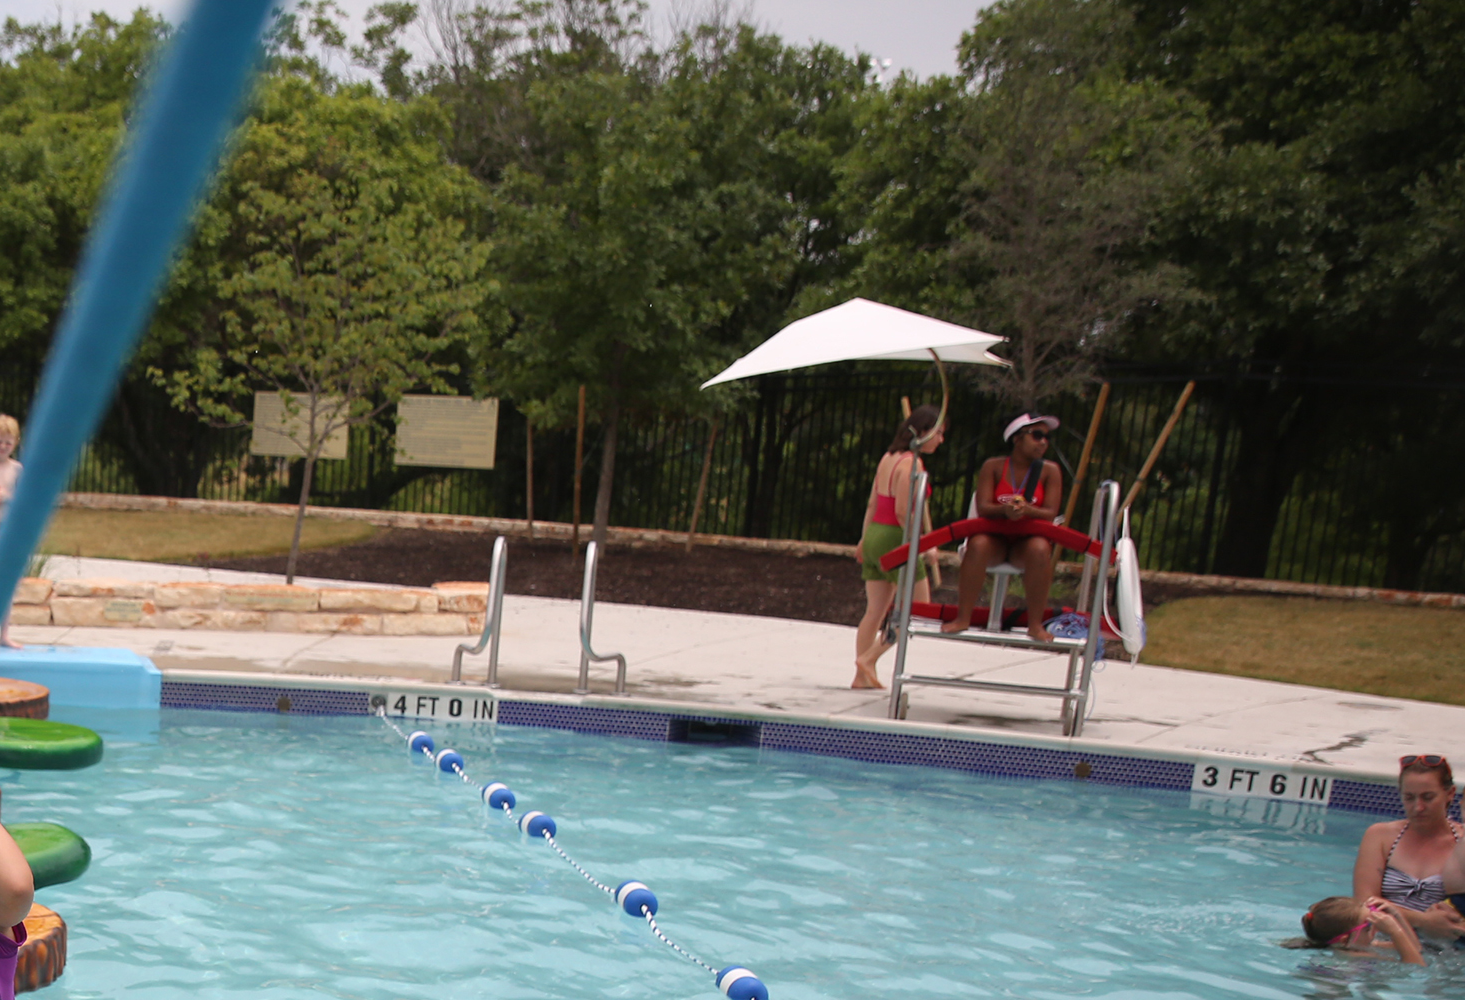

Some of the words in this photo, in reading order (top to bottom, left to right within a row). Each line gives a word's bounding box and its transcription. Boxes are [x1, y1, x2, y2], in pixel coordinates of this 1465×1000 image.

[394, 695, 407, 714] 4
[416, 696, 439, 715] FT
[449, 698, 463, 717] 0
[473, 699, 494, 719] IN
[1202, 766, 1219, 787] 3
[1229, 768, 1260, 792] FT
[1269, 774, 1288, 795] 6
[1300, 776, 1327, 800] IN
